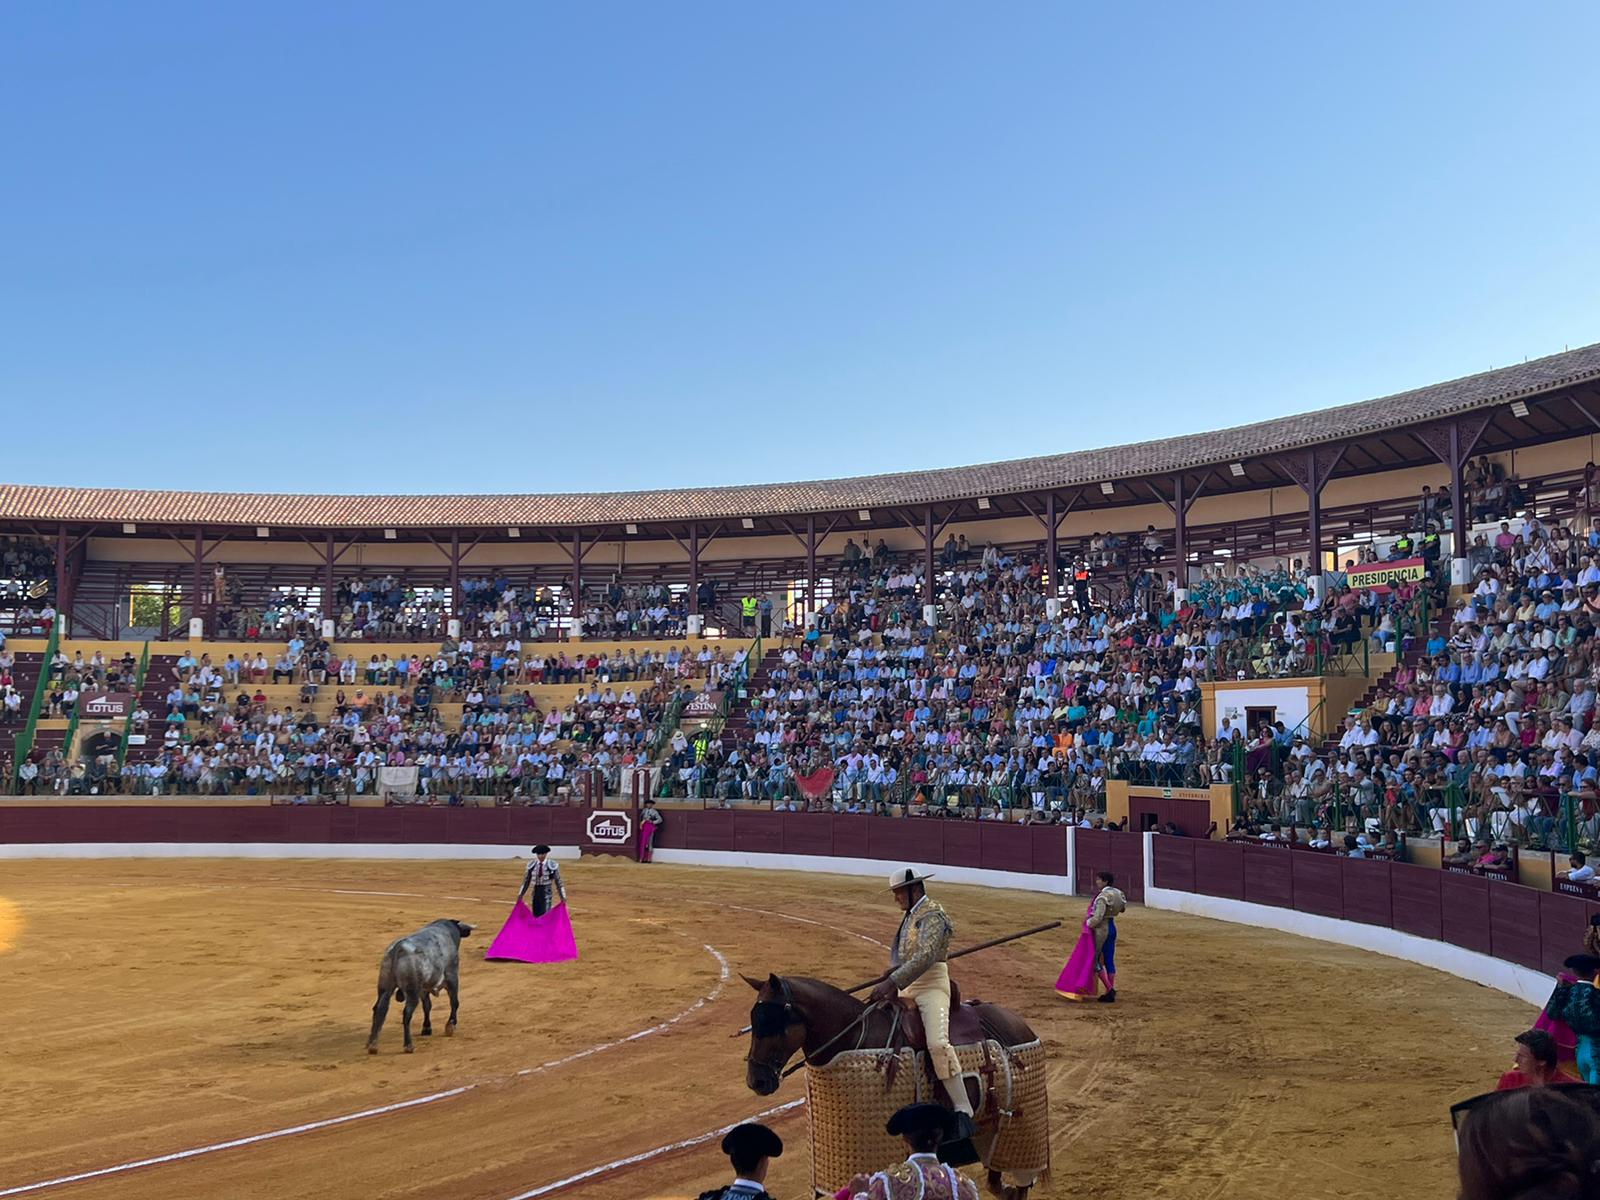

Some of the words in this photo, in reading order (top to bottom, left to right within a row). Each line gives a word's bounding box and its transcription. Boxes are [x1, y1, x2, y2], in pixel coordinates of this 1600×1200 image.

[1352, 568, 1418, 586] PRESIDENCIA
[86, 704, 124, 713] LOTUS
[686, 702, 717, 710] FESTINA
[594, 826, 625, 836] LOTUS
